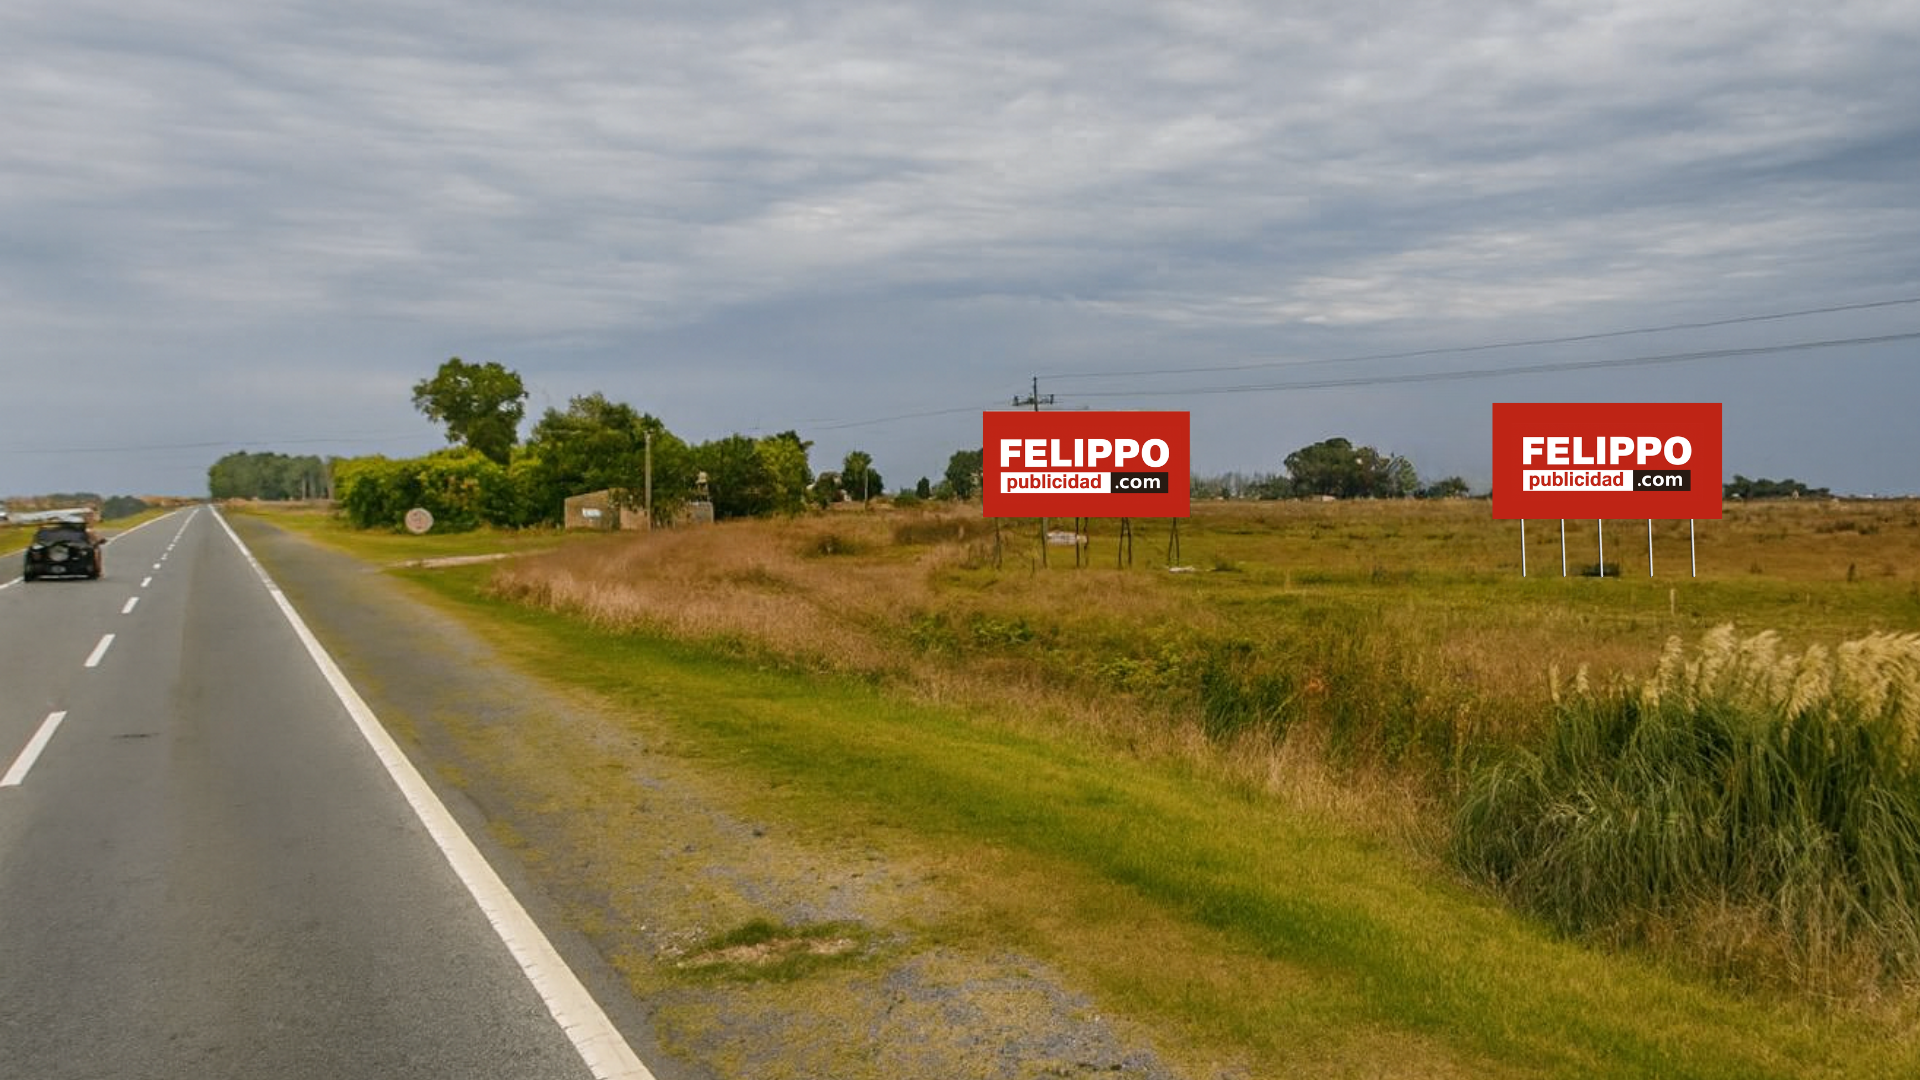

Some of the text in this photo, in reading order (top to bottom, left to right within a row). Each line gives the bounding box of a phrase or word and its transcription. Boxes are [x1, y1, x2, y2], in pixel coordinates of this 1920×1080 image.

[1000, 438, 1169, 468] FELIPPO
[1522, 436, 1692, 465] FELIPPO
[1007, 474, 1161, 492] publicidad .com
[1529, 471, 1683, 490] publicidad .com
